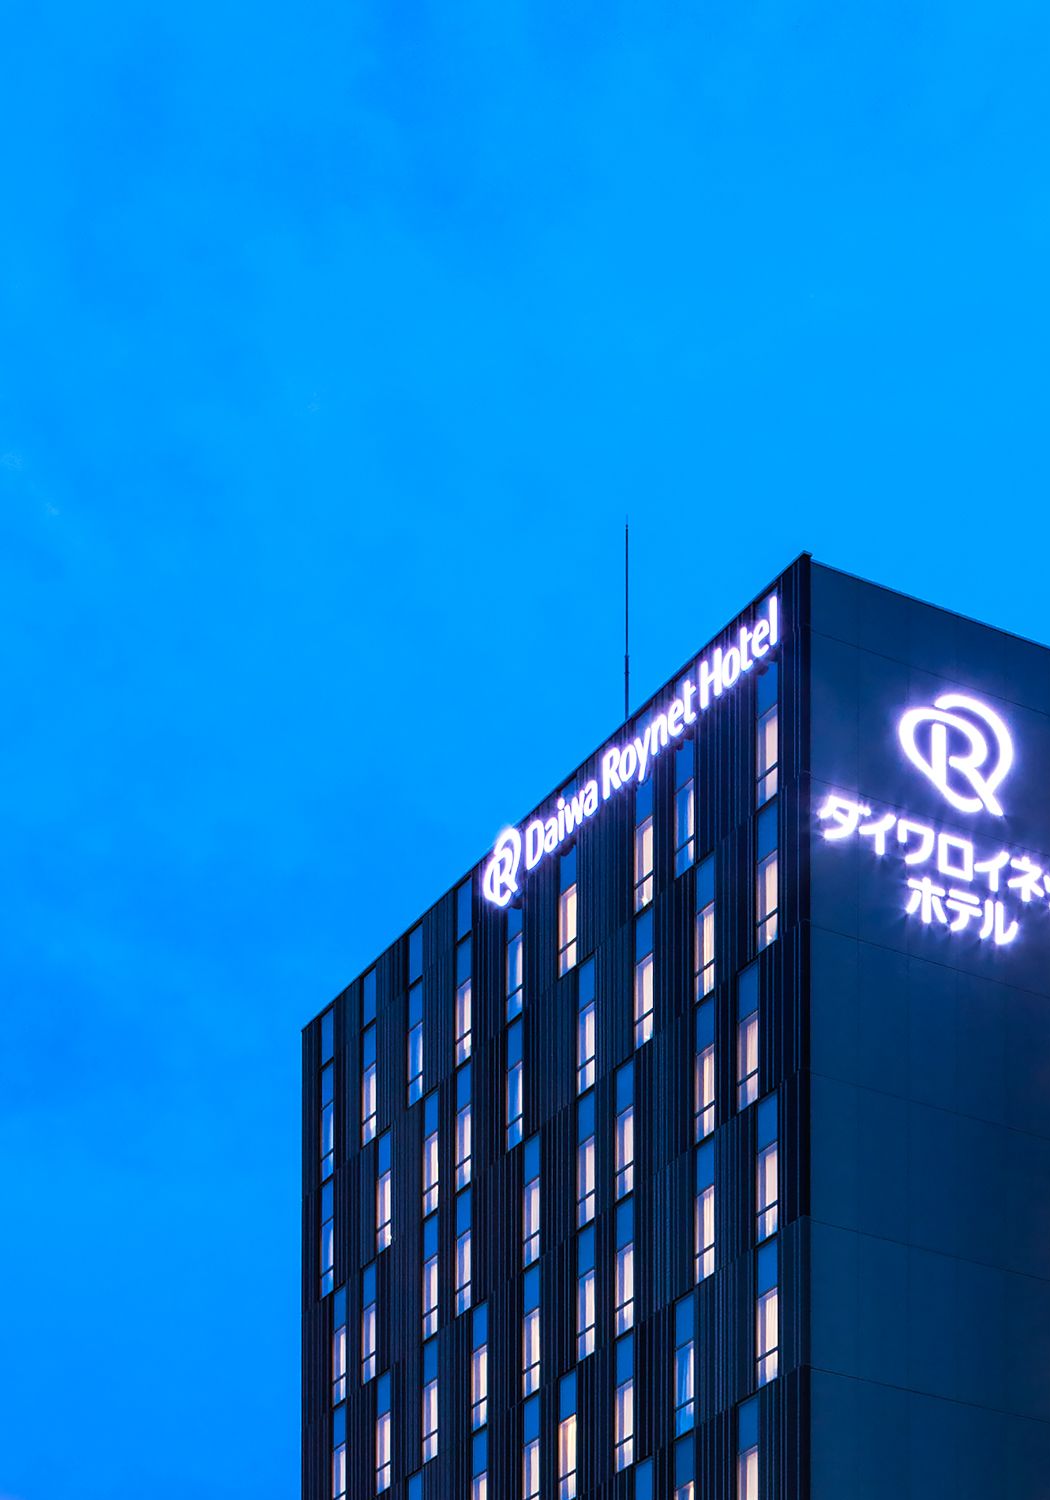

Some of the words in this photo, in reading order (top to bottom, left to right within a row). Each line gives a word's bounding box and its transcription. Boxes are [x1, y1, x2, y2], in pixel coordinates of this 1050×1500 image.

[526, 780, 598, 871] Daiwa
[603, 680, 696, 800] Roynet
[701, 596, 777, 709] Hotel
[906, 877, 1018, 944] ホテル
